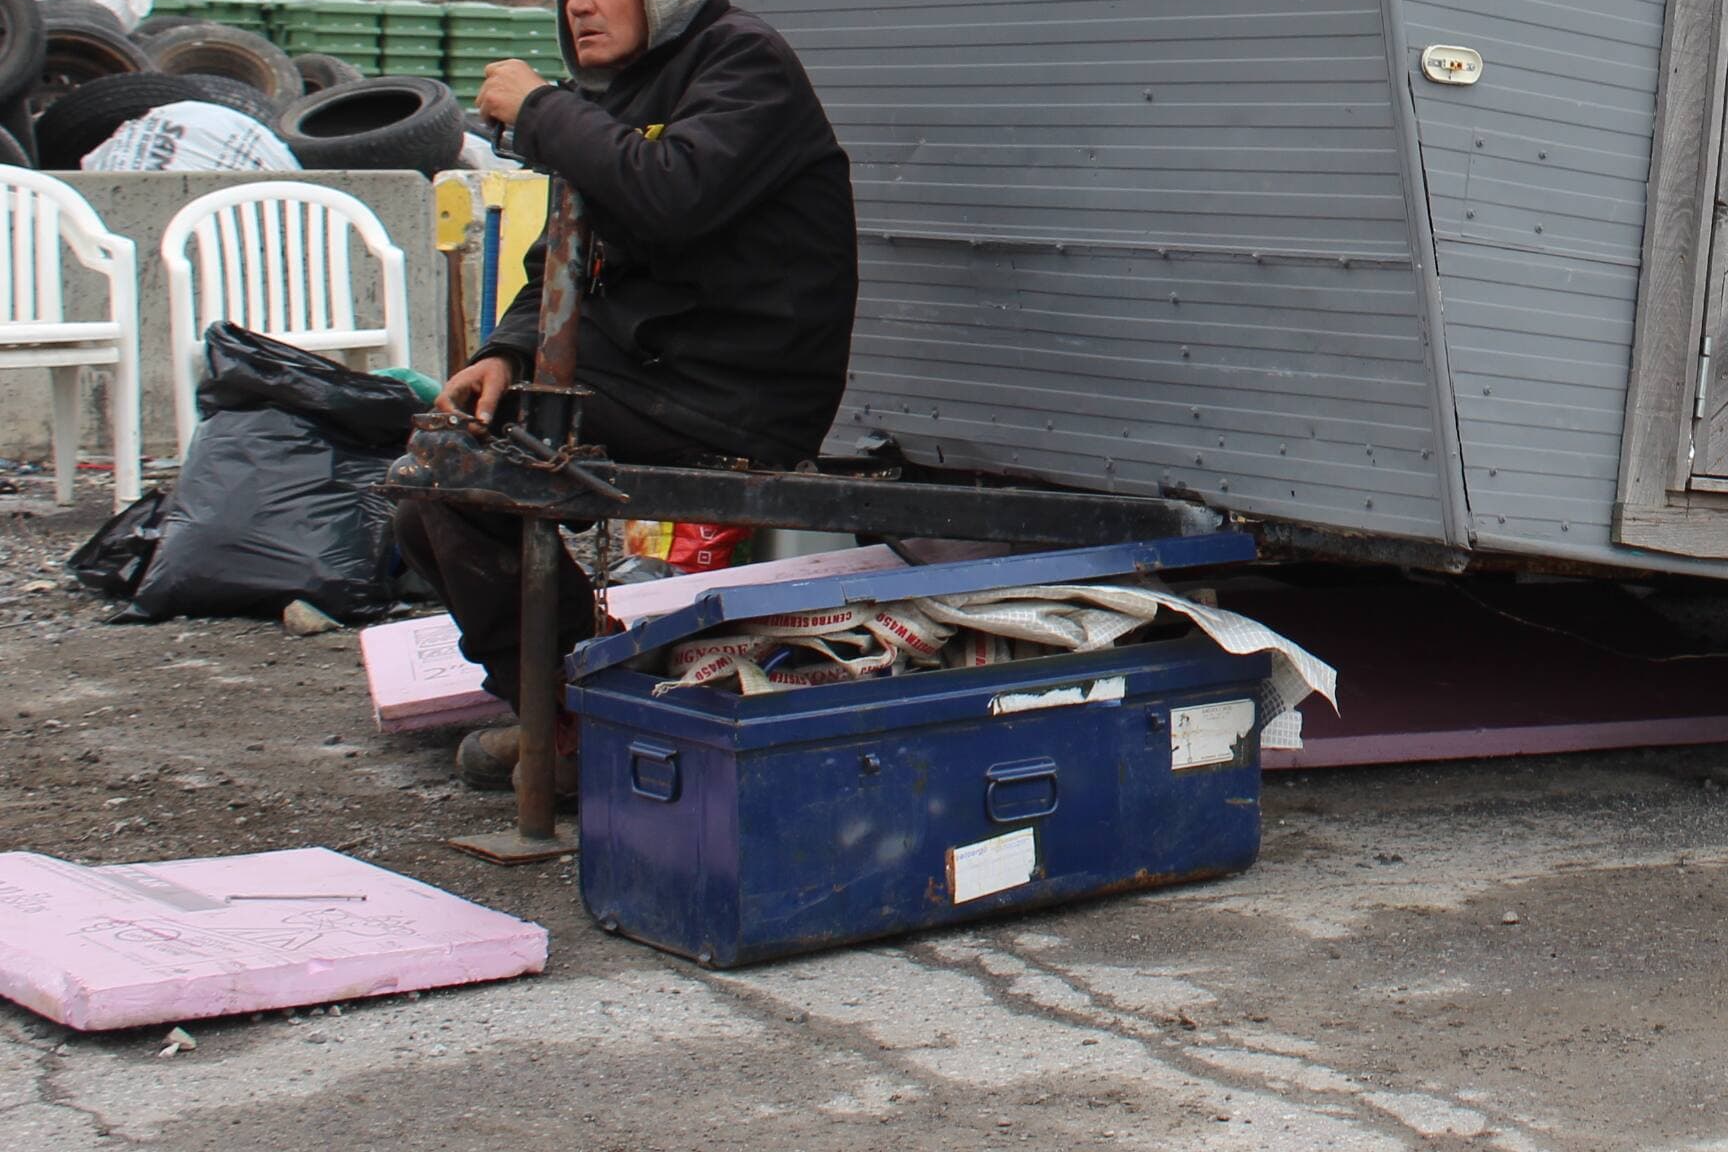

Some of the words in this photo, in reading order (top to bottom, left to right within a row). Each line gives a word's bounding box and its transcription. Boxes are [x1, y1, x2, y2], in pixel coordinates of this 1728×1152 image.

[811, 611, 853, 627] CENTRO
[875, 612, 910, 640] W450
[695, 655, 729, 681] W450
